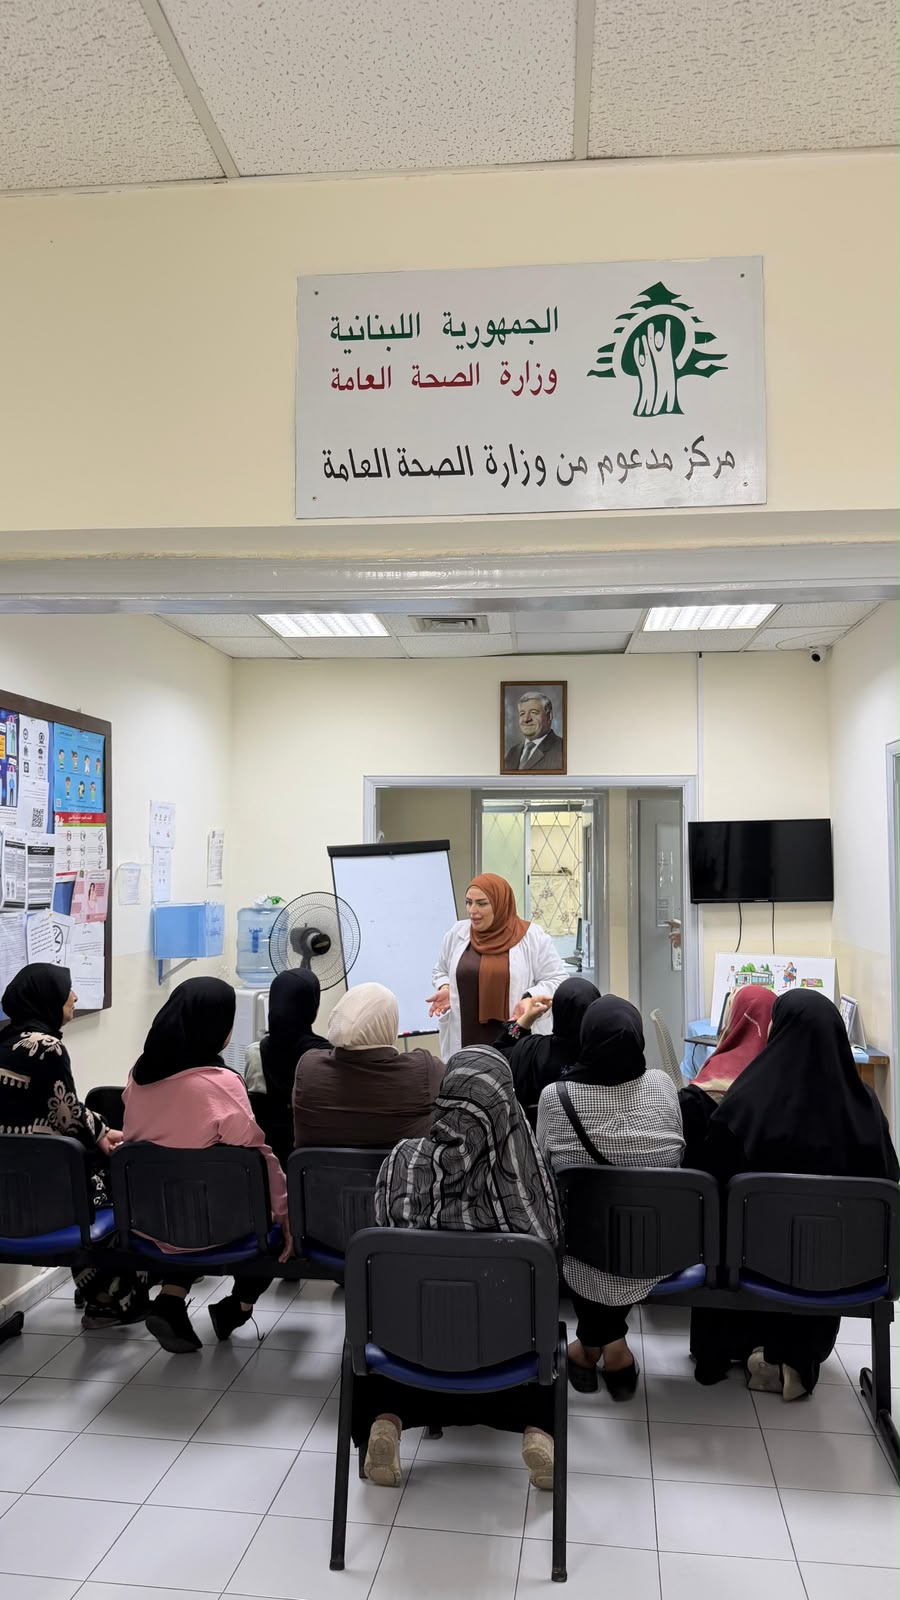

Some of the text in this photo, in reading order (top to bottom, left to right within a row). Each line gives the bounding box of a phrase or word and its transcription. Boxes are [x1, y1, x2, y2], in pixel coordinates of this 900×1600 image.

[330, 305, 559, 355] الجمهورية اللبنانية
[330, 359, 558, 397] وزارة الصحة العامة
[321, 434, 736, 489] مركز مدعوم من وزارة الصحة العامة
